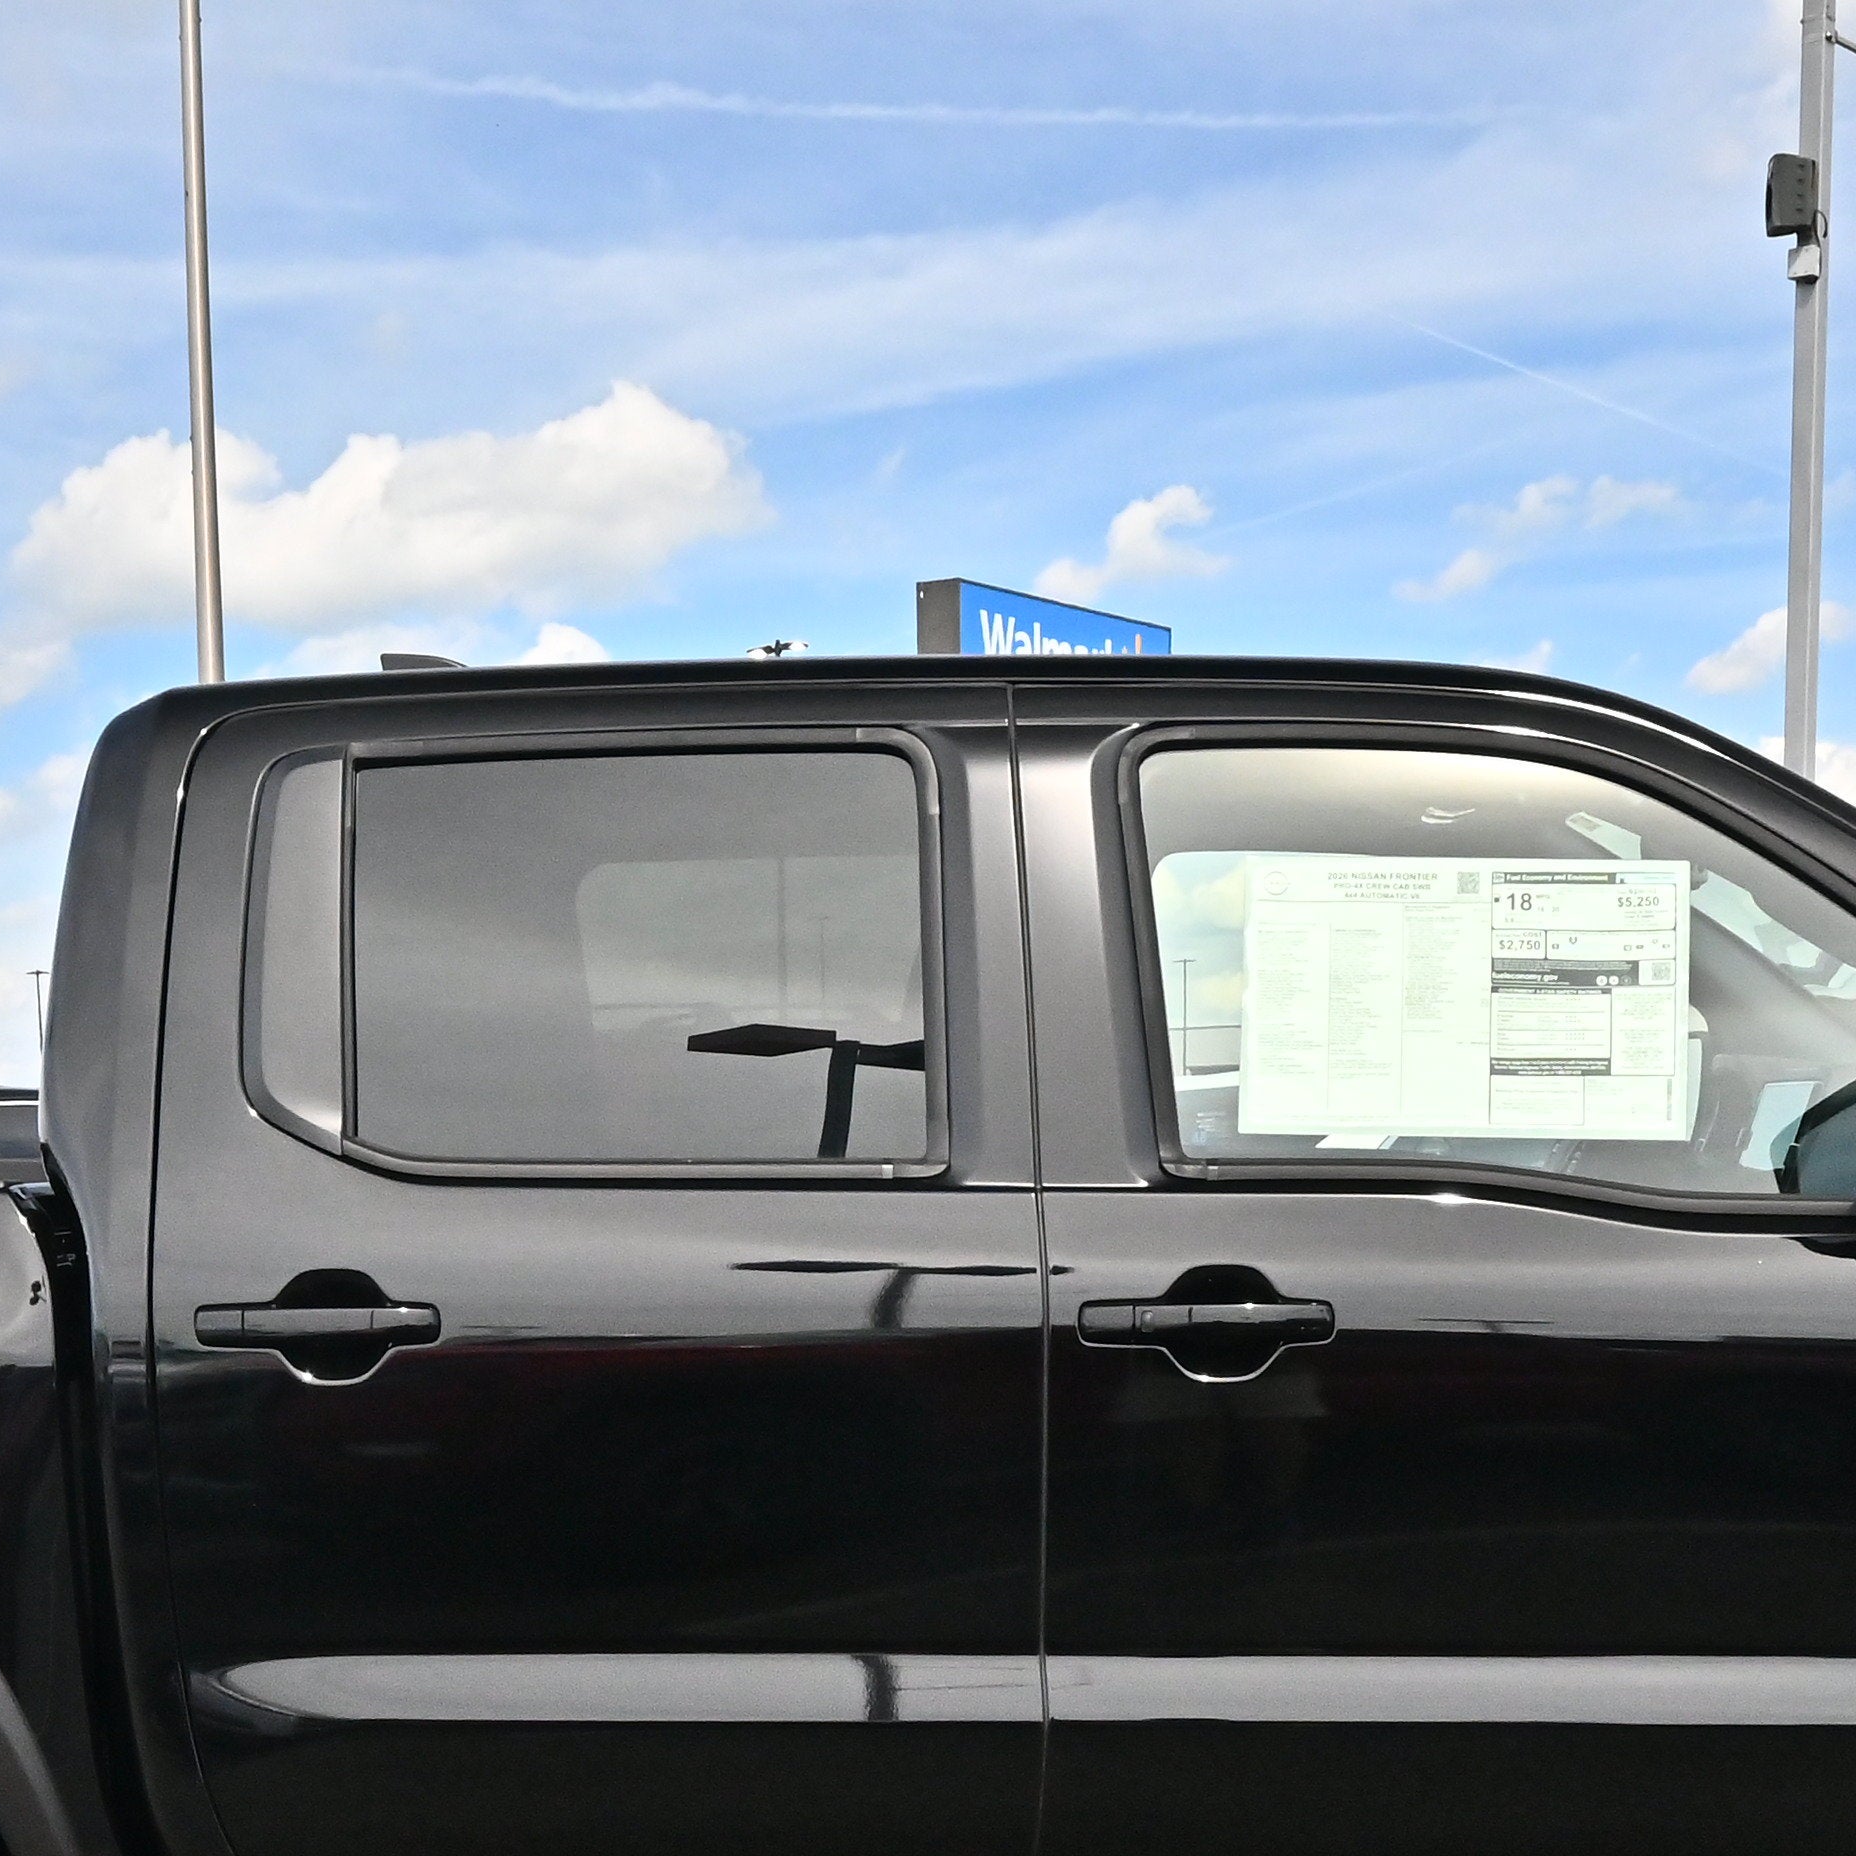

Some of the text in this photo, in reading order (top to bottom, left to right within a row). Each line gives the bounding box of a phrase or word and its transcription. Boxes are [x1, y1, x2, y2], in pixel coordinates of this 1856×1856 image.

[1351, 872, 1387, 880] NISSAN
[1390, 872, 1438, 881] FRONTIER
[1360, 892, 1408, 900] AUTOMATIC
[1507, 892, 1532, 911] 18
[1499, 939, 1541, 951] $2,750
